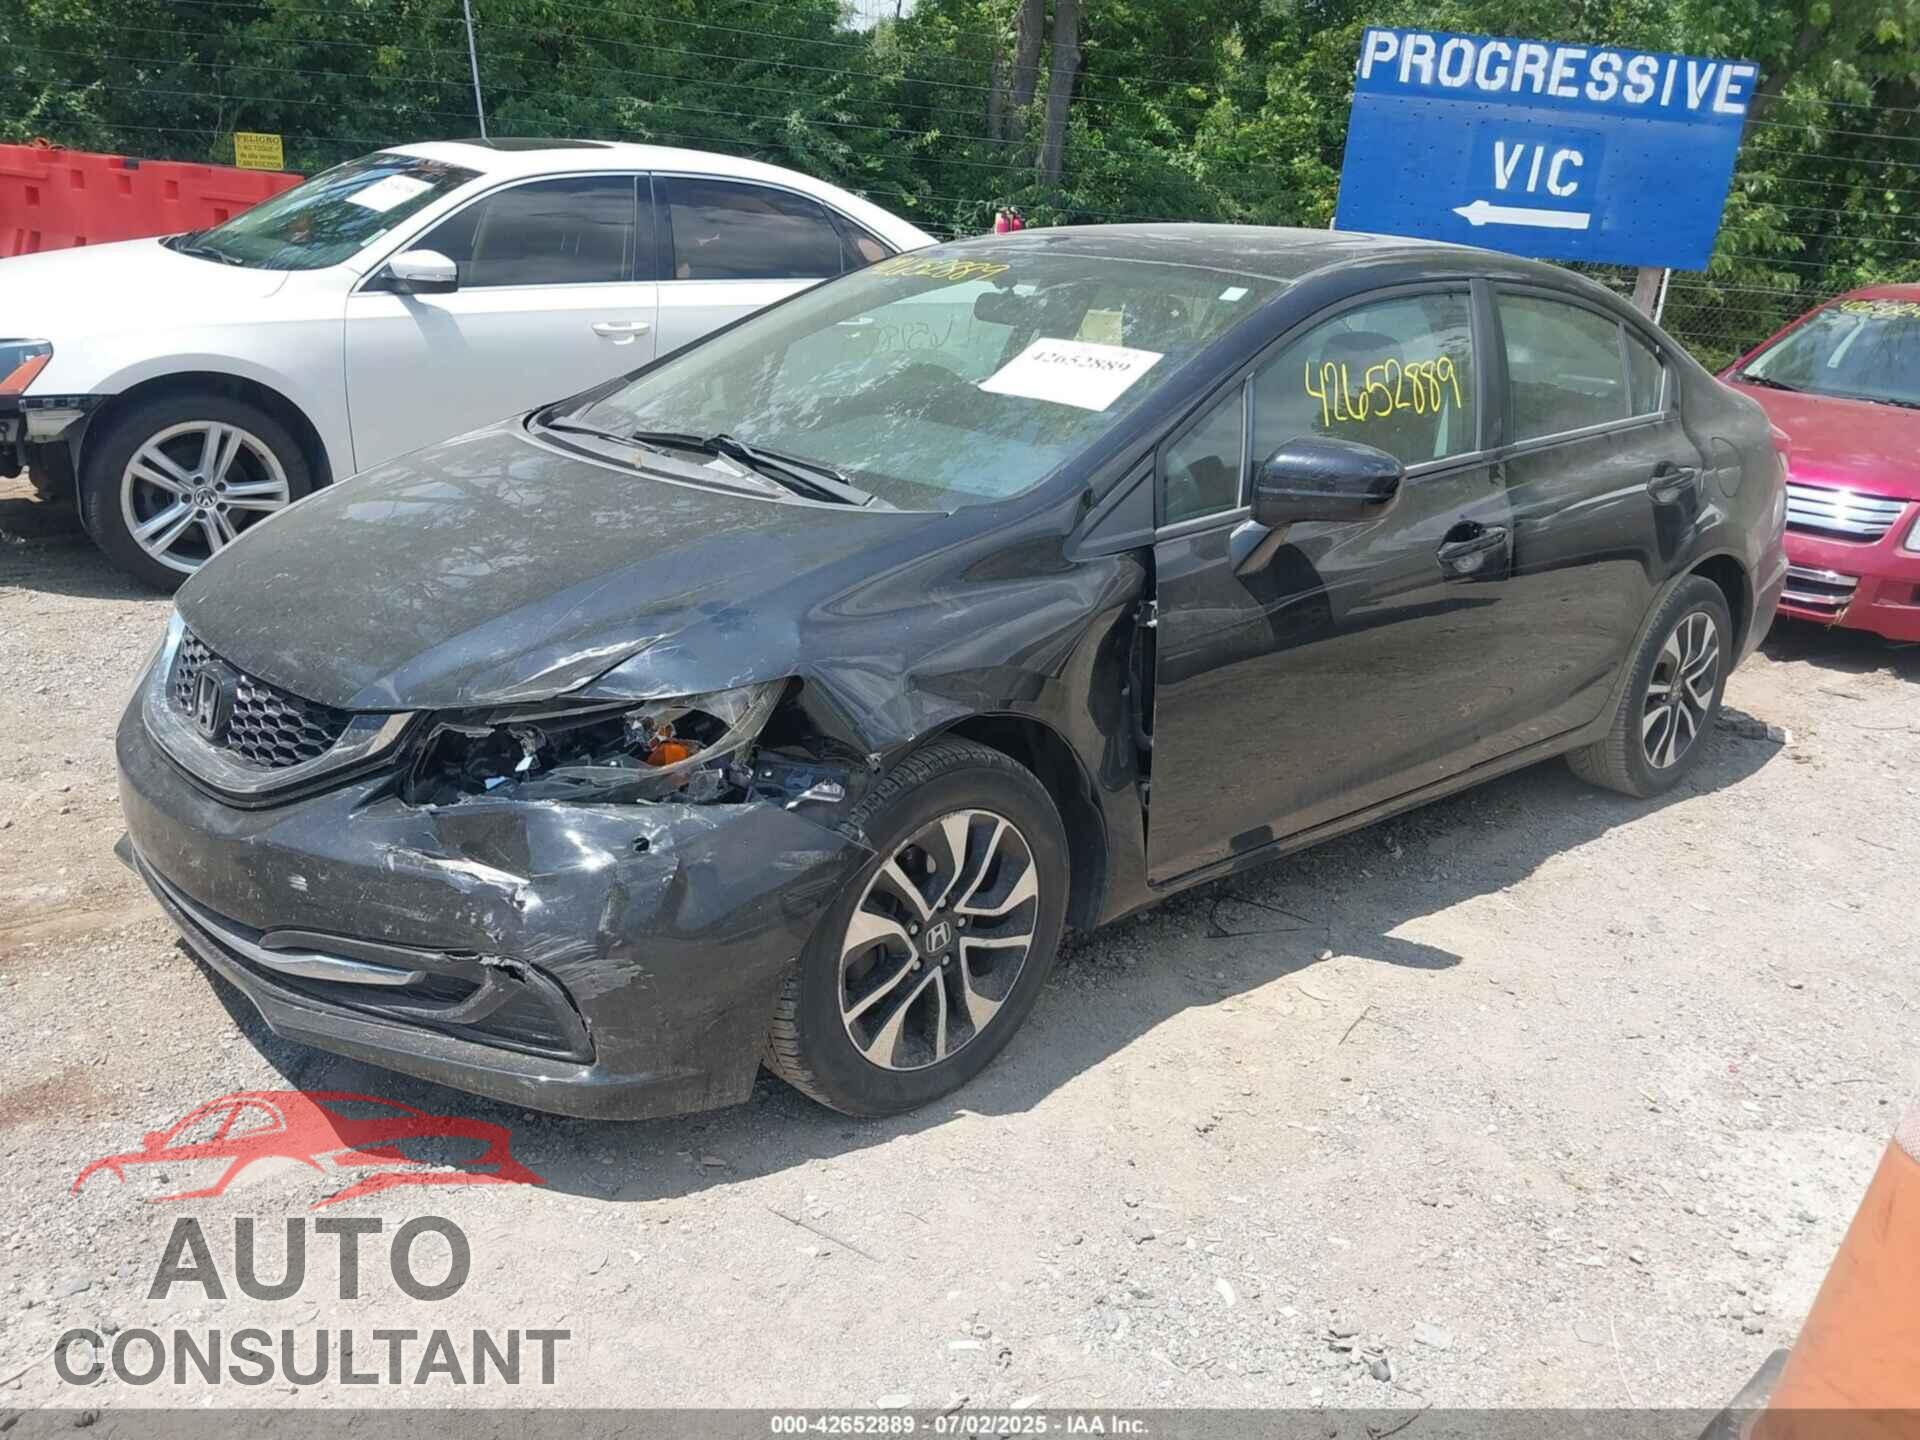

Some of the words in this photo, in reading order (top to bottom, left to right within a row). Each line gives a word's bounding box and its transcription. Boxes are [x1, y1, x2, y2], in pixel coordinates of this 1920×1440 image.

[1361, 31, 1755, 114] PROGRESSIVE
[1494, 141, 1583, 196] VIC
[1305, 357, 1461, 426] 42652889
